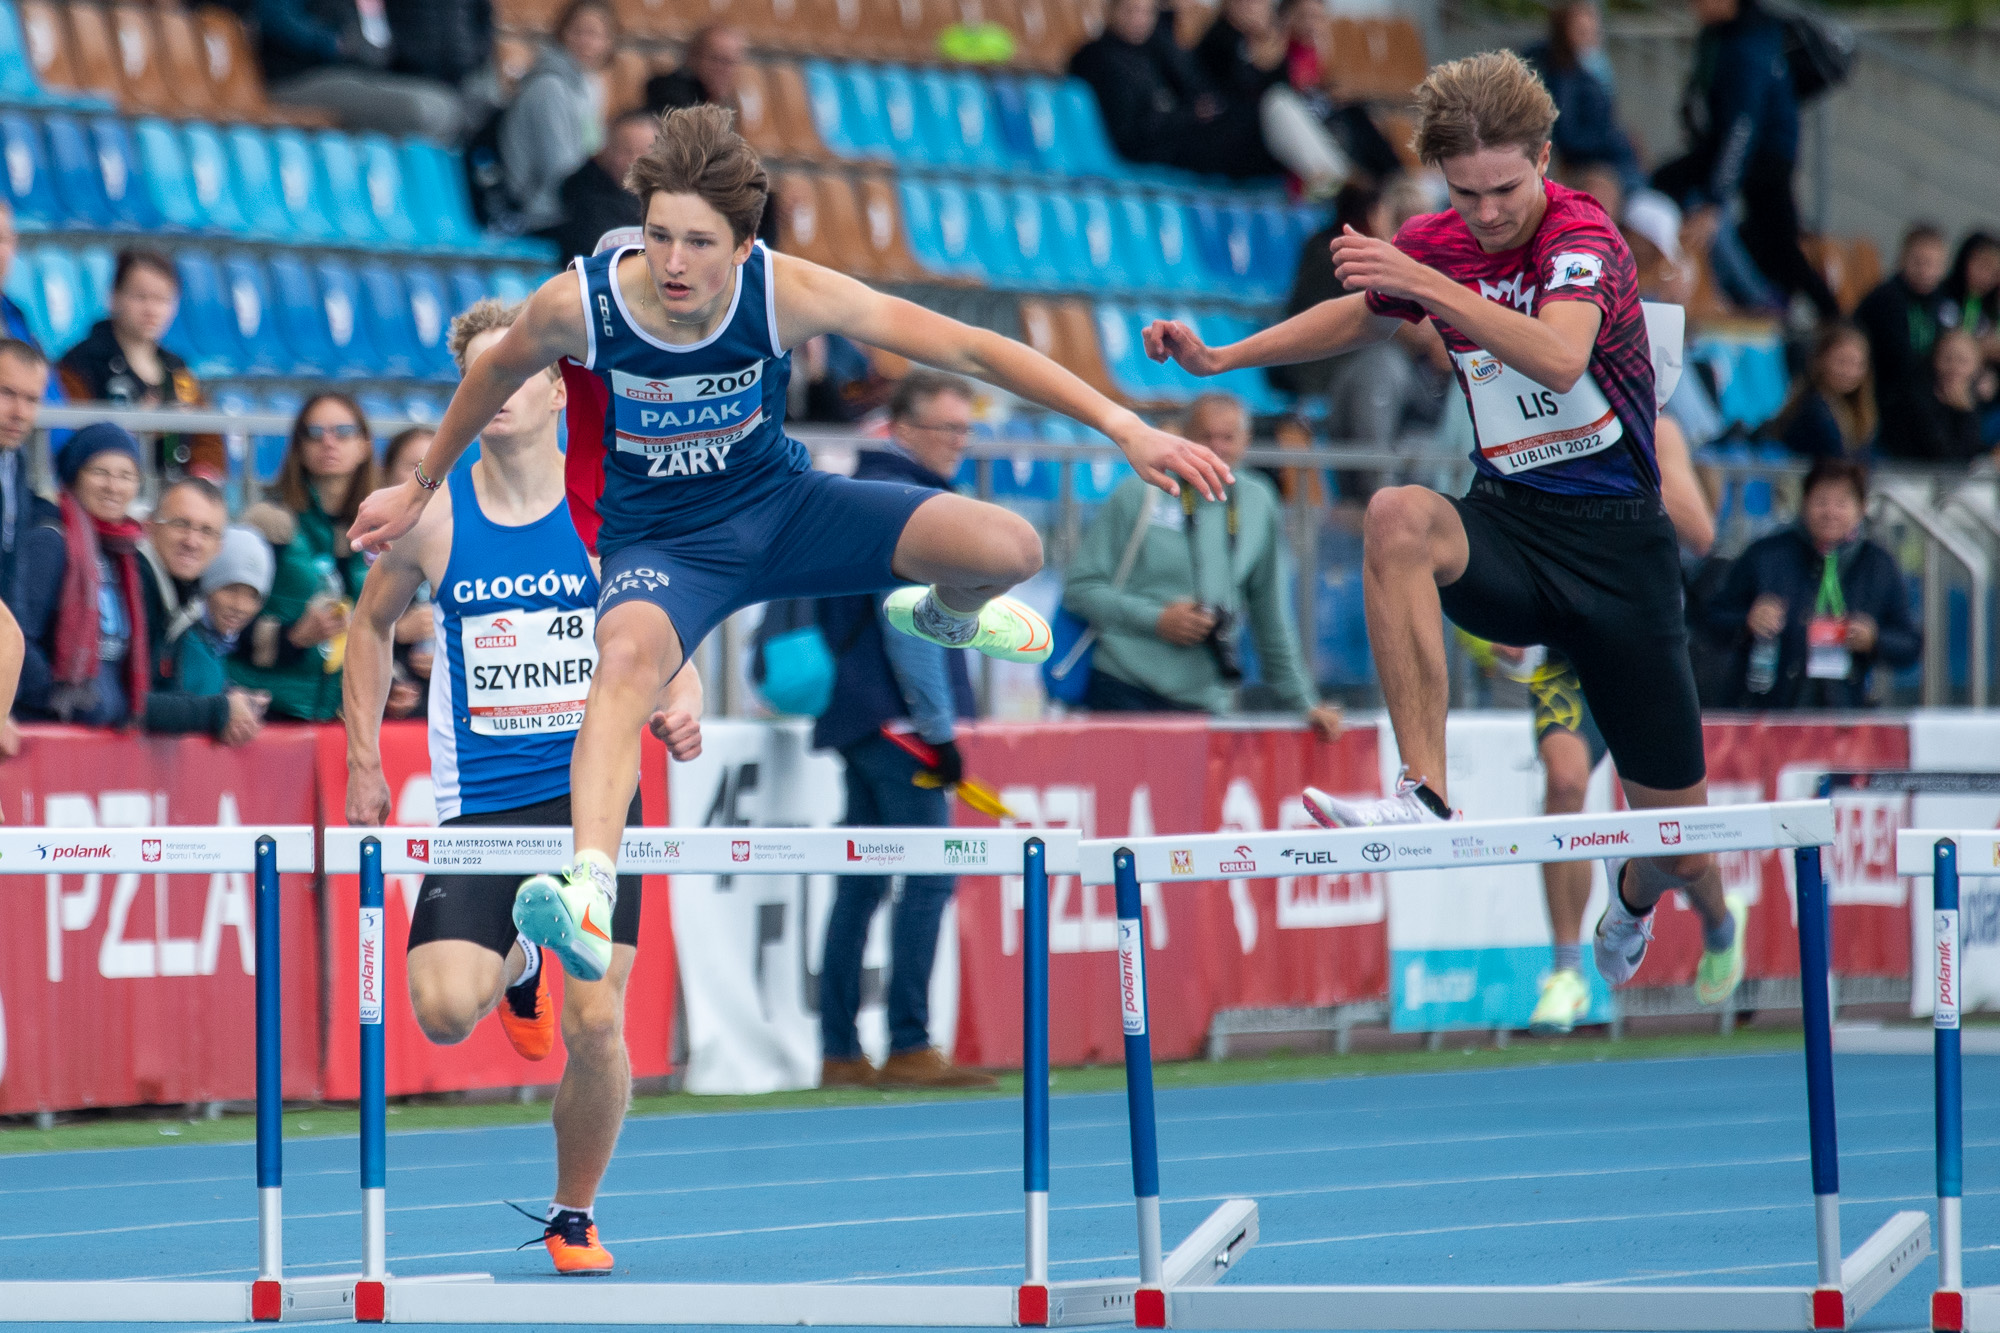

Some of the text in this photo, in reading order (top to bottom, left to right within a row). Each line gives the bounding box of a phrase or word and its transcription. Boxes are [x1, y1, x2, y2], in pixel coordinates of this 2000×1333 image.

[1475, 364, 1496, 376] LOTTO
[696, 369, 756, 397] 200
[628, 389, 671, 400] ORLEN
[1517, 391, 1558, 420] LIS
[640, 401, 742, 428] PAJĄK
[643, 440, 698, 454] LUBLIN
[705, 430, 743, 446] 2022
[1509, 444, 1562, 468] LUBLIN
[1565, 434, 1603, 453] 2022
[453, 569, 587, 604] GŁOGÓW
[604, 568, 669, 592] ROS
[547, 615, 584, 640] 48
[476, 636, 515, 647] ORLEN
[473, 658, 593, 691] SZYRNER
[493, 713, 583, 731] LUBLIN 2022
[433, 840, 563, 848] PZLA MISTRZOSTWA POLSKI U16
[964, 841, 986, 854] AZS
[1570, 830, 1630, 850] polanik
[53, 844, 112, 861] polanik
[166, 852, 187, 860] Sportu
[192, 852, 221, 860] Turystyki
[625, 841, 662, 858] lublin
[754, 852, 774, 860] Sportu
[779, 852, 806, 861] Turystyki
[858, 844, 905, 854] lubelskie
[1280, 849, 1295, 857] 4F
[1295, 851, 1337, 864] FUEL
[1398, 846, 1432, 857] Okęcie
[963, 855, 986, 864] LUBLIN
[1221, 863, 1254, 872] ORLEN
[362, 939, 376, 1003] polanik
[1937, 941, 1954, 1006] polanik
[1121, 950, 1138, 1013] polanik
[360, 1009, 378, 1017] IAAF
